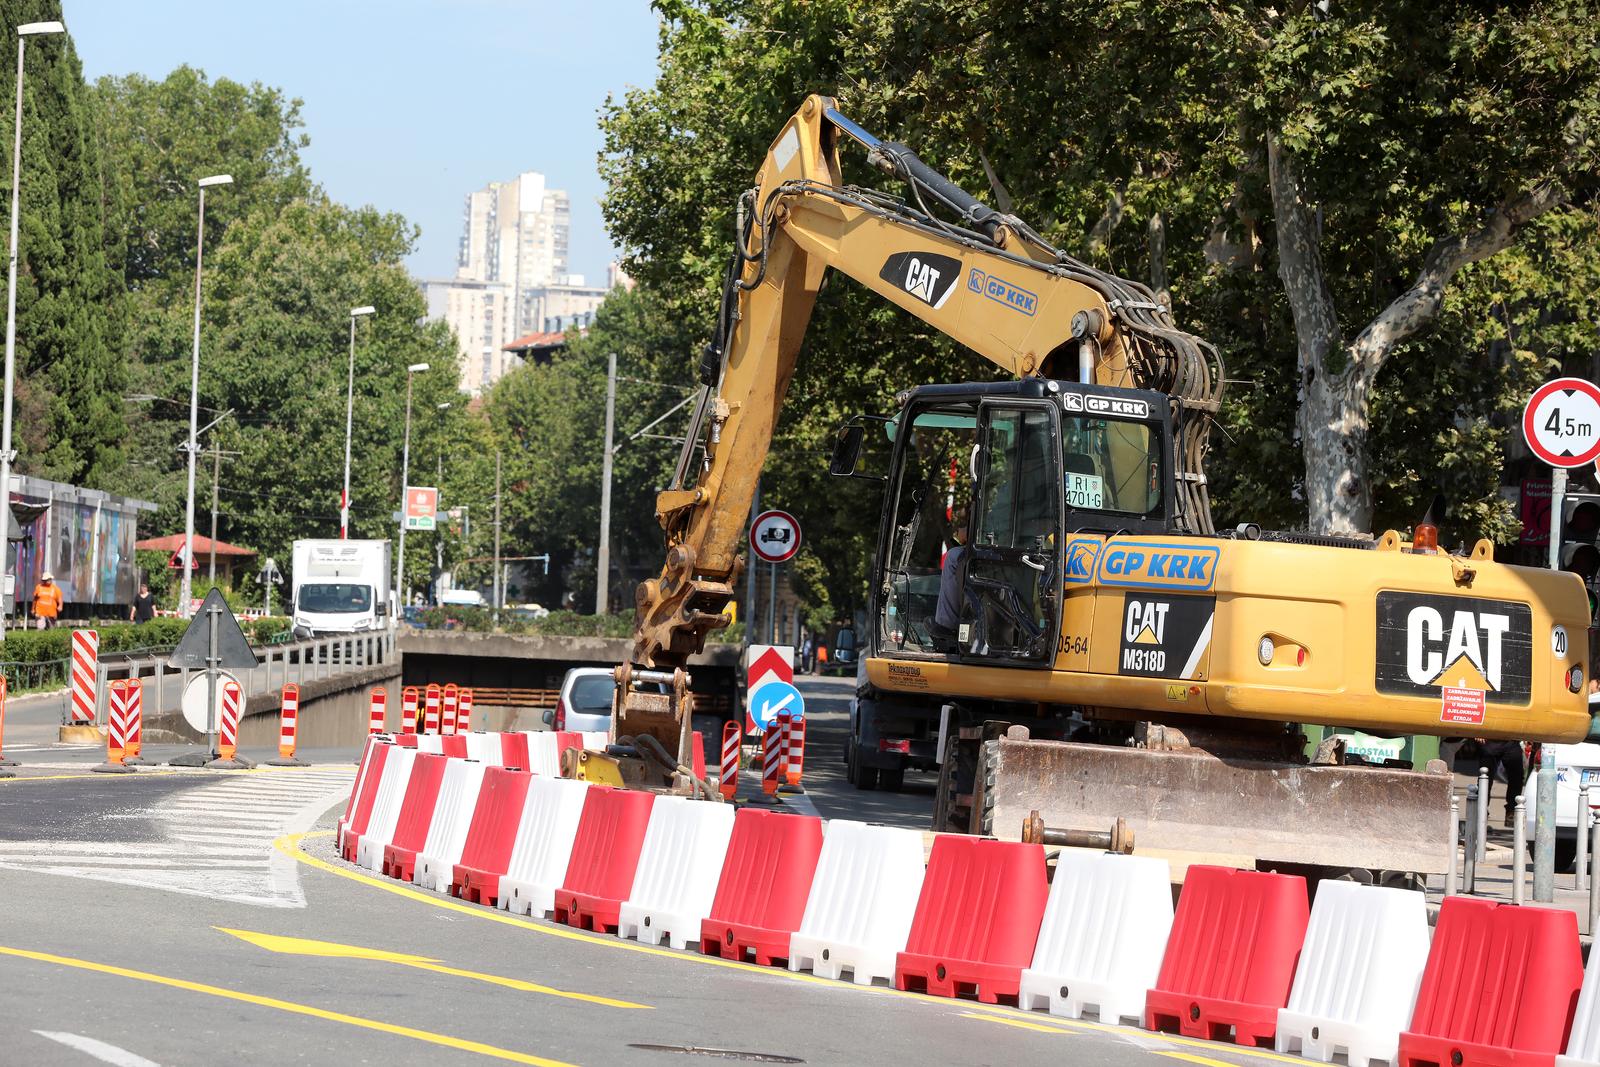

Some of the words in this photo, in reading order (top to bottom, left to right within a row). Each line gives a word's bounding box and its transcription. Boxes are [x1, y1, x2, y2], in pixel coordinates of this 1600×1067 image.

[905, 258, 940, 303] CAT
[988, 282, 1005, 297] GP
[1006, 288, 1034, 311] KRK
[1088, 399, 1109, 411] GP
[1112, 401, 1145, 415] KRK
[1075, 476, 1088, 491] RI
[1105, 551, 1145, 575] GP
[1147, 554, 1211, 580] KRK
[1125, 600, 1170, 645] CAT
[1407, 606, 1510, 692] CAT
[1554, 631, 1565, 653] 20
[1123, 648, 1166, 672] M318D
